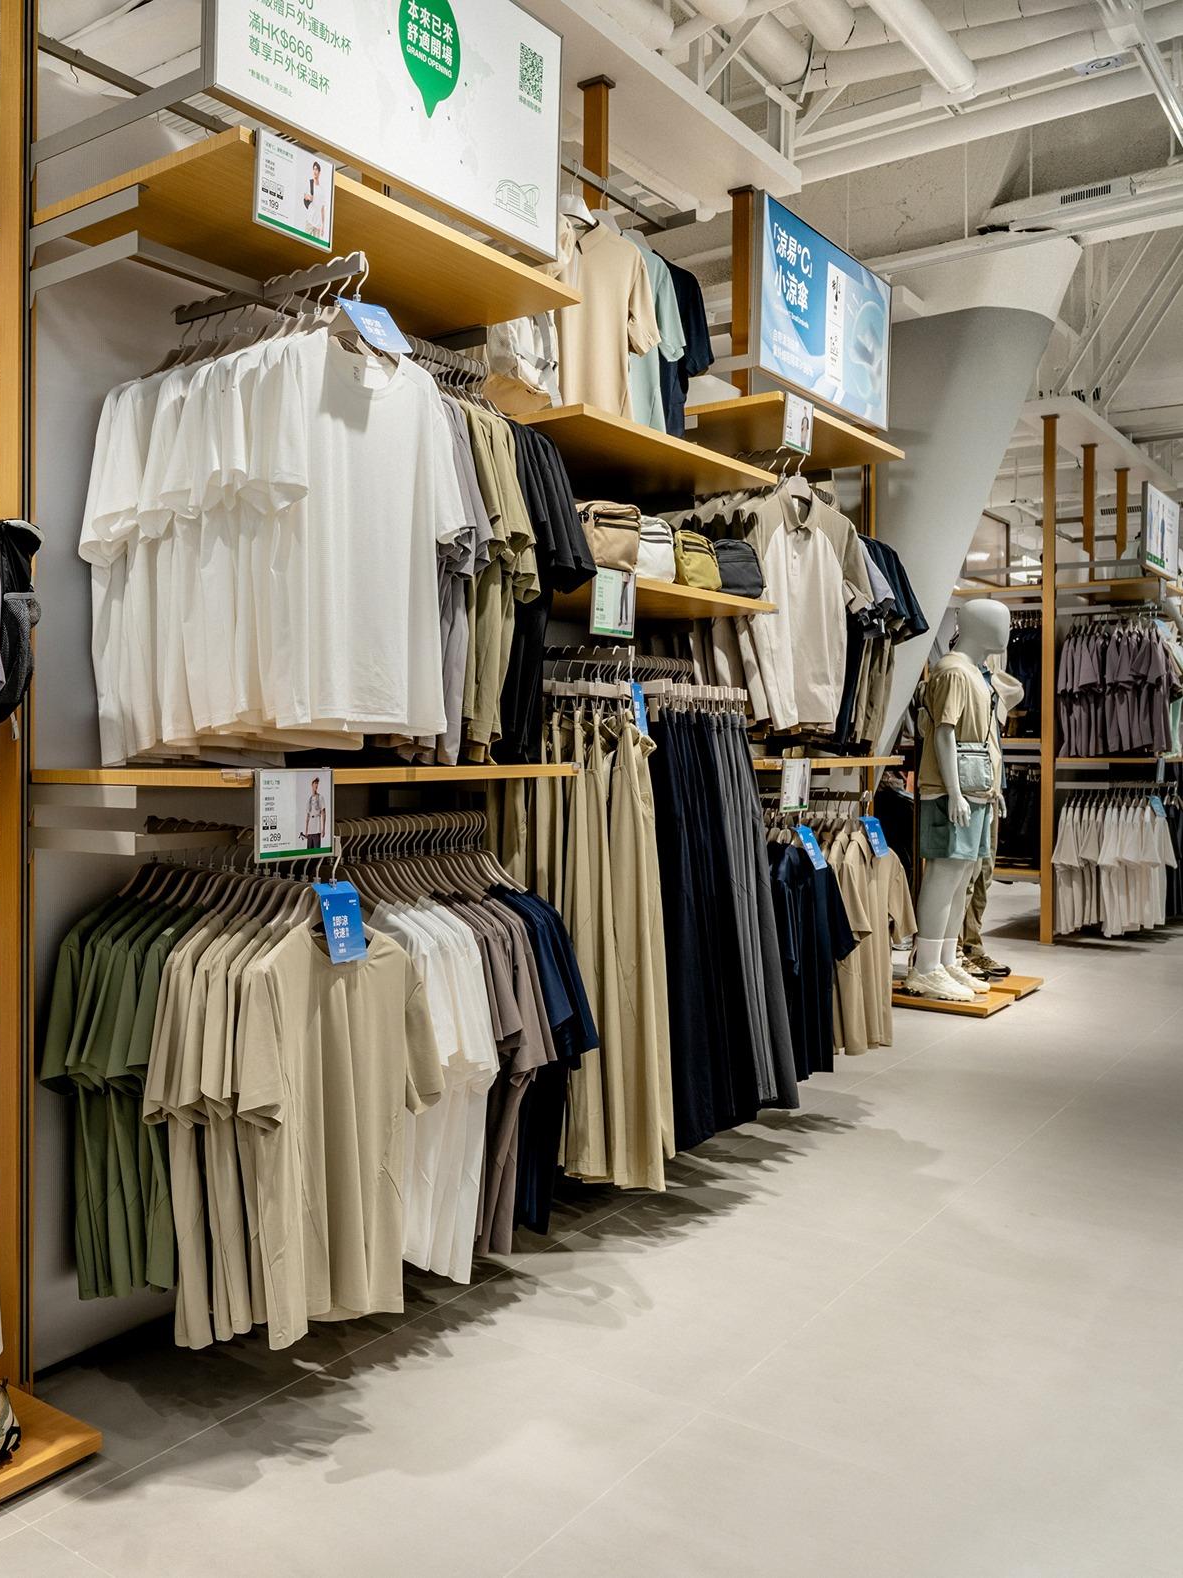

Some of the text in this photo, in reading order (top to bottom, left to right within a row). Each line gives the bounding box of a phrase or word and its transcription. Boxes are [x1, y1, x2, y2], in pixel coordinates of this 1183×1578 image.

[248, 9, 313, 63] 滿HK$666
[407, 0, 453, 44] 本來已來
[407, 21, 453, 67] 舒適開場
[248, 34, 331, 96] 尊享戶外保溫杯
[406, 44, 453, 79] GRAND OPENING
[774, 264, 809, 313] 小涼傘
[269, 832, 282, 843] 269
